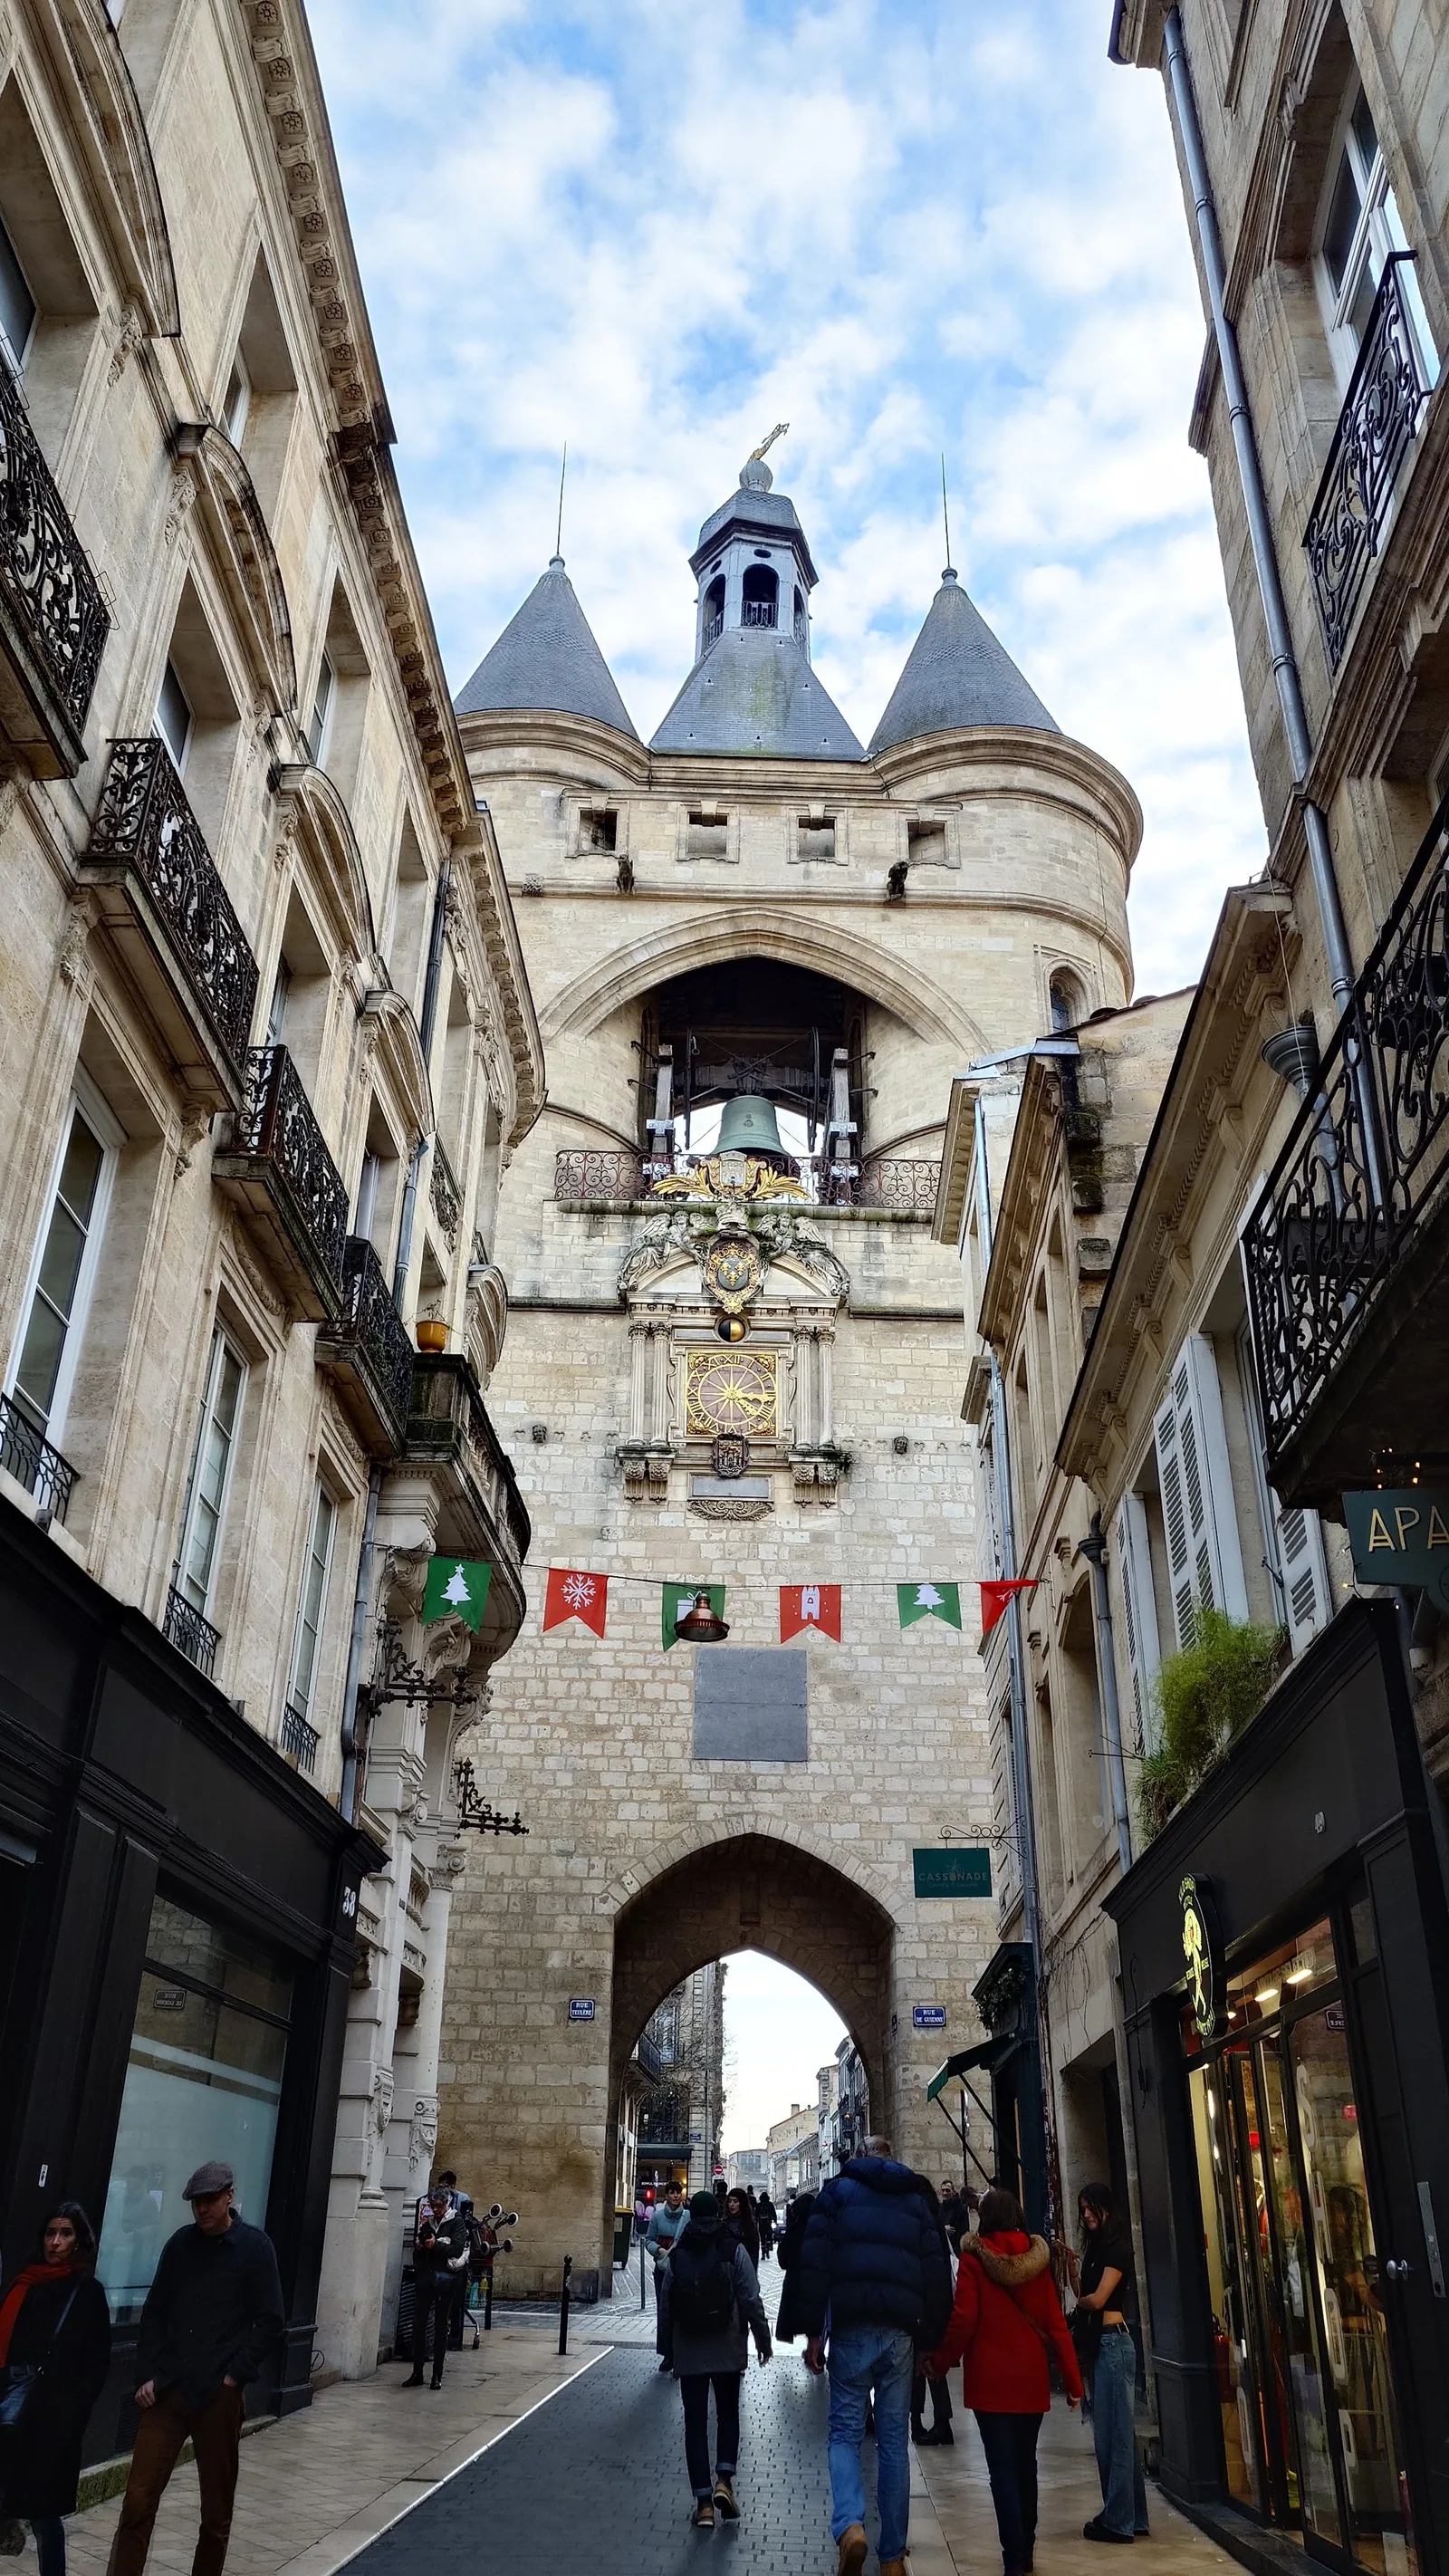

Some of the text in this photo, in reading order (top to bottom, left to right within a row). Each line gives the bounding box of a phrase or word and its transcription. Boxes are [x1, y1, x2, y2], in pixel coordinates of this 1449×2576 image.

[724, 1355, 741, 1364] XII
[1368, 1505, 1449, 1552] APA
[918, 1871, 988, 1881] CASSONADE
[342, 1886, 356, 1918] 38
